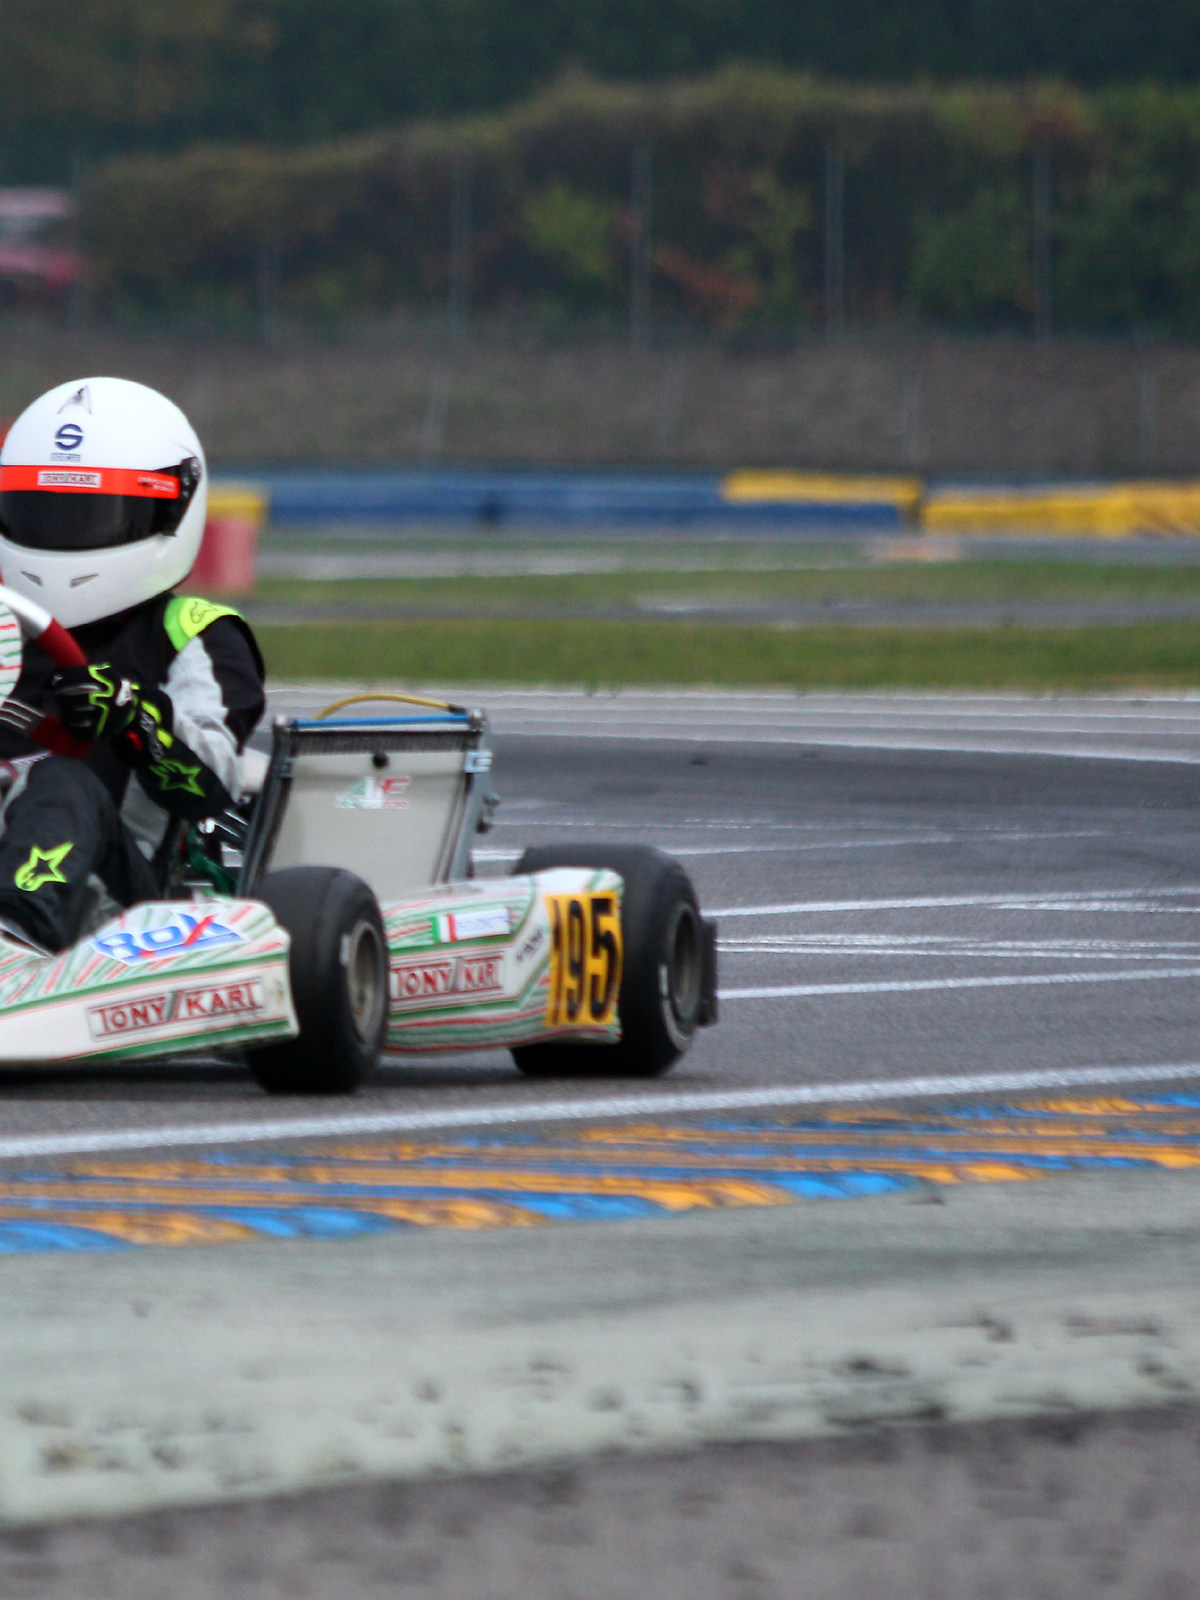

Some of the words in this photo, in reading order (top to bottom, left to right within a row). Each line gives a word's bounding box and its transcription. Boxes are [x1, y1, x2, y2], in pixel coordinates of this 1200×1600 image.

[55, 423, 83, 451] S
[392, 962, 451, 998] TONY
[551, 898, 619, 1024] 195
[91, 997, 165, 1033] TONY
[183, 982, 260, 1016] KART
